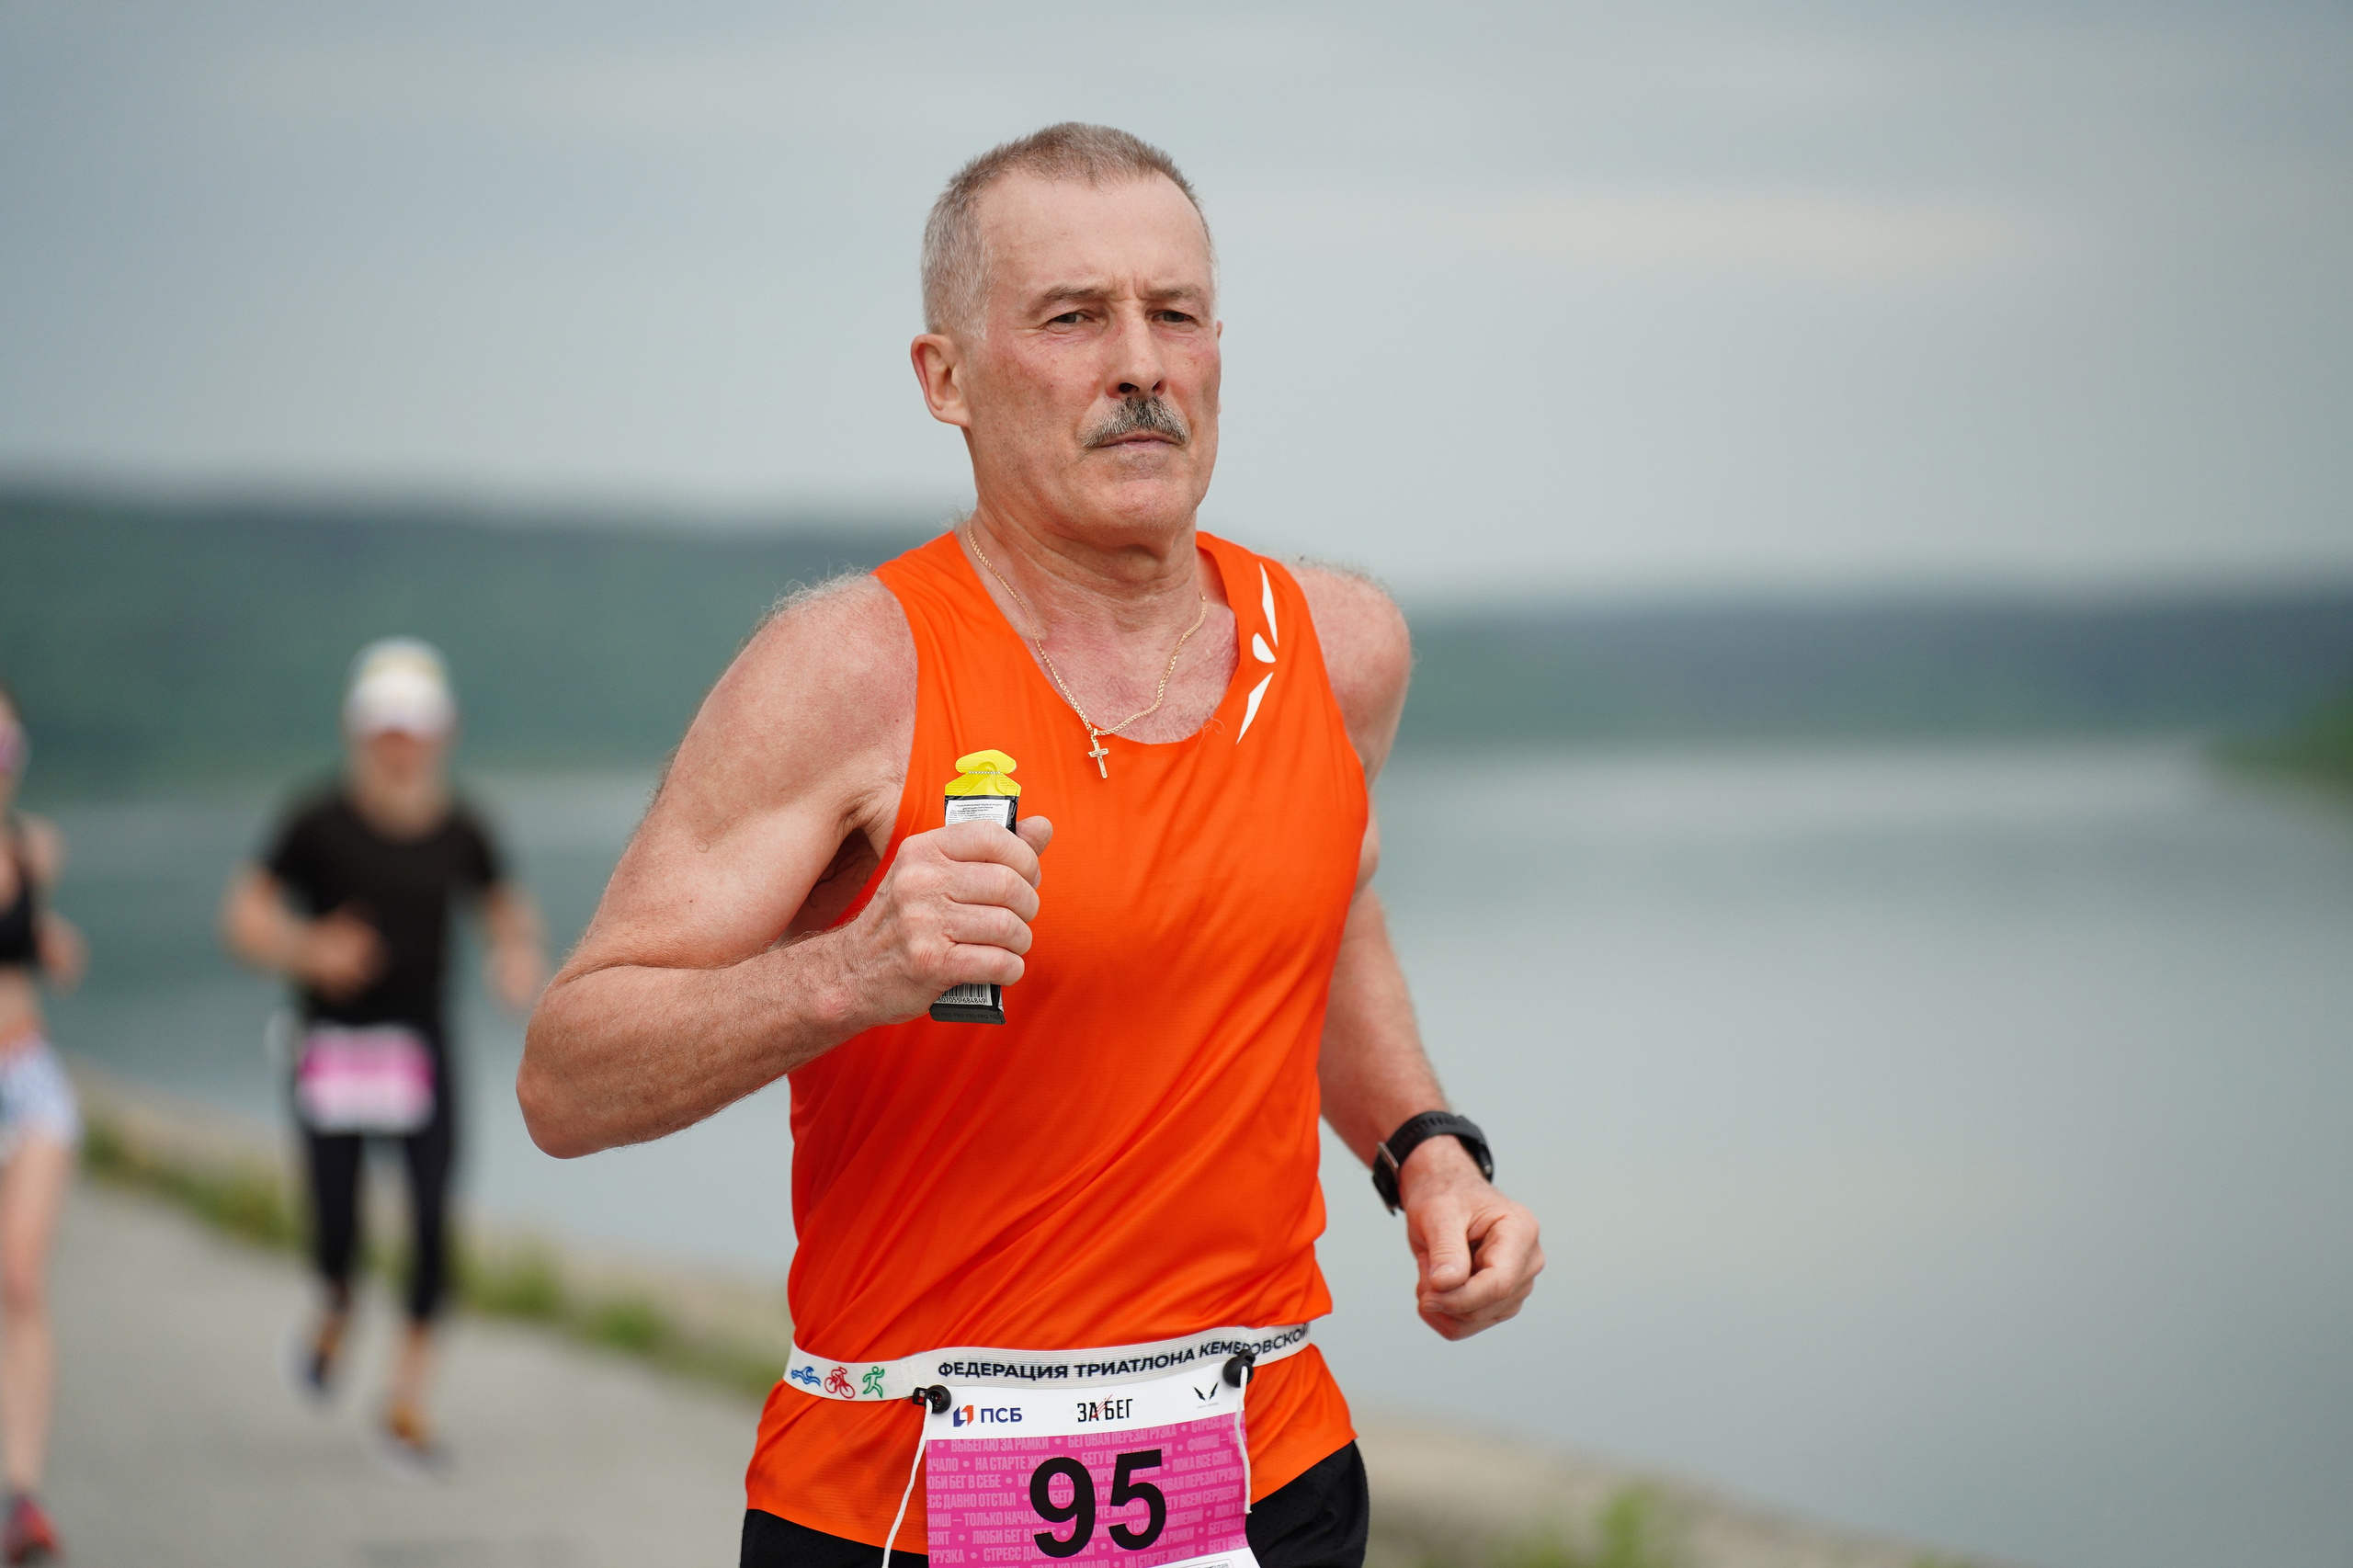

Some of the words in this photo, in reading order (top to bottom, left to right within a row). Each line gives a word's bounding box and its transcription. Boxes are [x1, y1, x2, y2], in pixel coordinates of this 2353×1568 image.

[938, 1362, 1068, 1381] ФЕДЕРАЦИЯ
[1074, 1349, 1195, 1378] ТРИАТЛОНА
[981, 1407, 1022, 1423] ПСБ
[950, 1438, 999, 1453] ВЫБЕГАЮ
[1001, 1437, 1014, 1451] ЗА
[1015, 1437, 1049, 1451] РАМКИ
[1068, 1432, 1110, 1449] БЕГОВАЯ
[975, 1456, 989, 1471] НА
[990, 1455, 1027, 1471] СТАРТЕ
[949, 1475, 967, 1489] БЕГ
[968, 1474, 975, 1489] В
[976, 1473, 1002, 1488] СЕБЕ
[944, 1494, 977, 1509] ДАВНО
[978, 1492, 1016, 1507] ОТСТАЛ
[1029, 1449, 1165, 1558] 95
[963, 1512, 1004, 1527] ТОЛЬКО
[972, 1529, 1003, 1544] ЛЮБИ
[1005, 1528, 1023, 1543] БЕГ
[983, 1546, 1022, 1562] СТРЕСС
